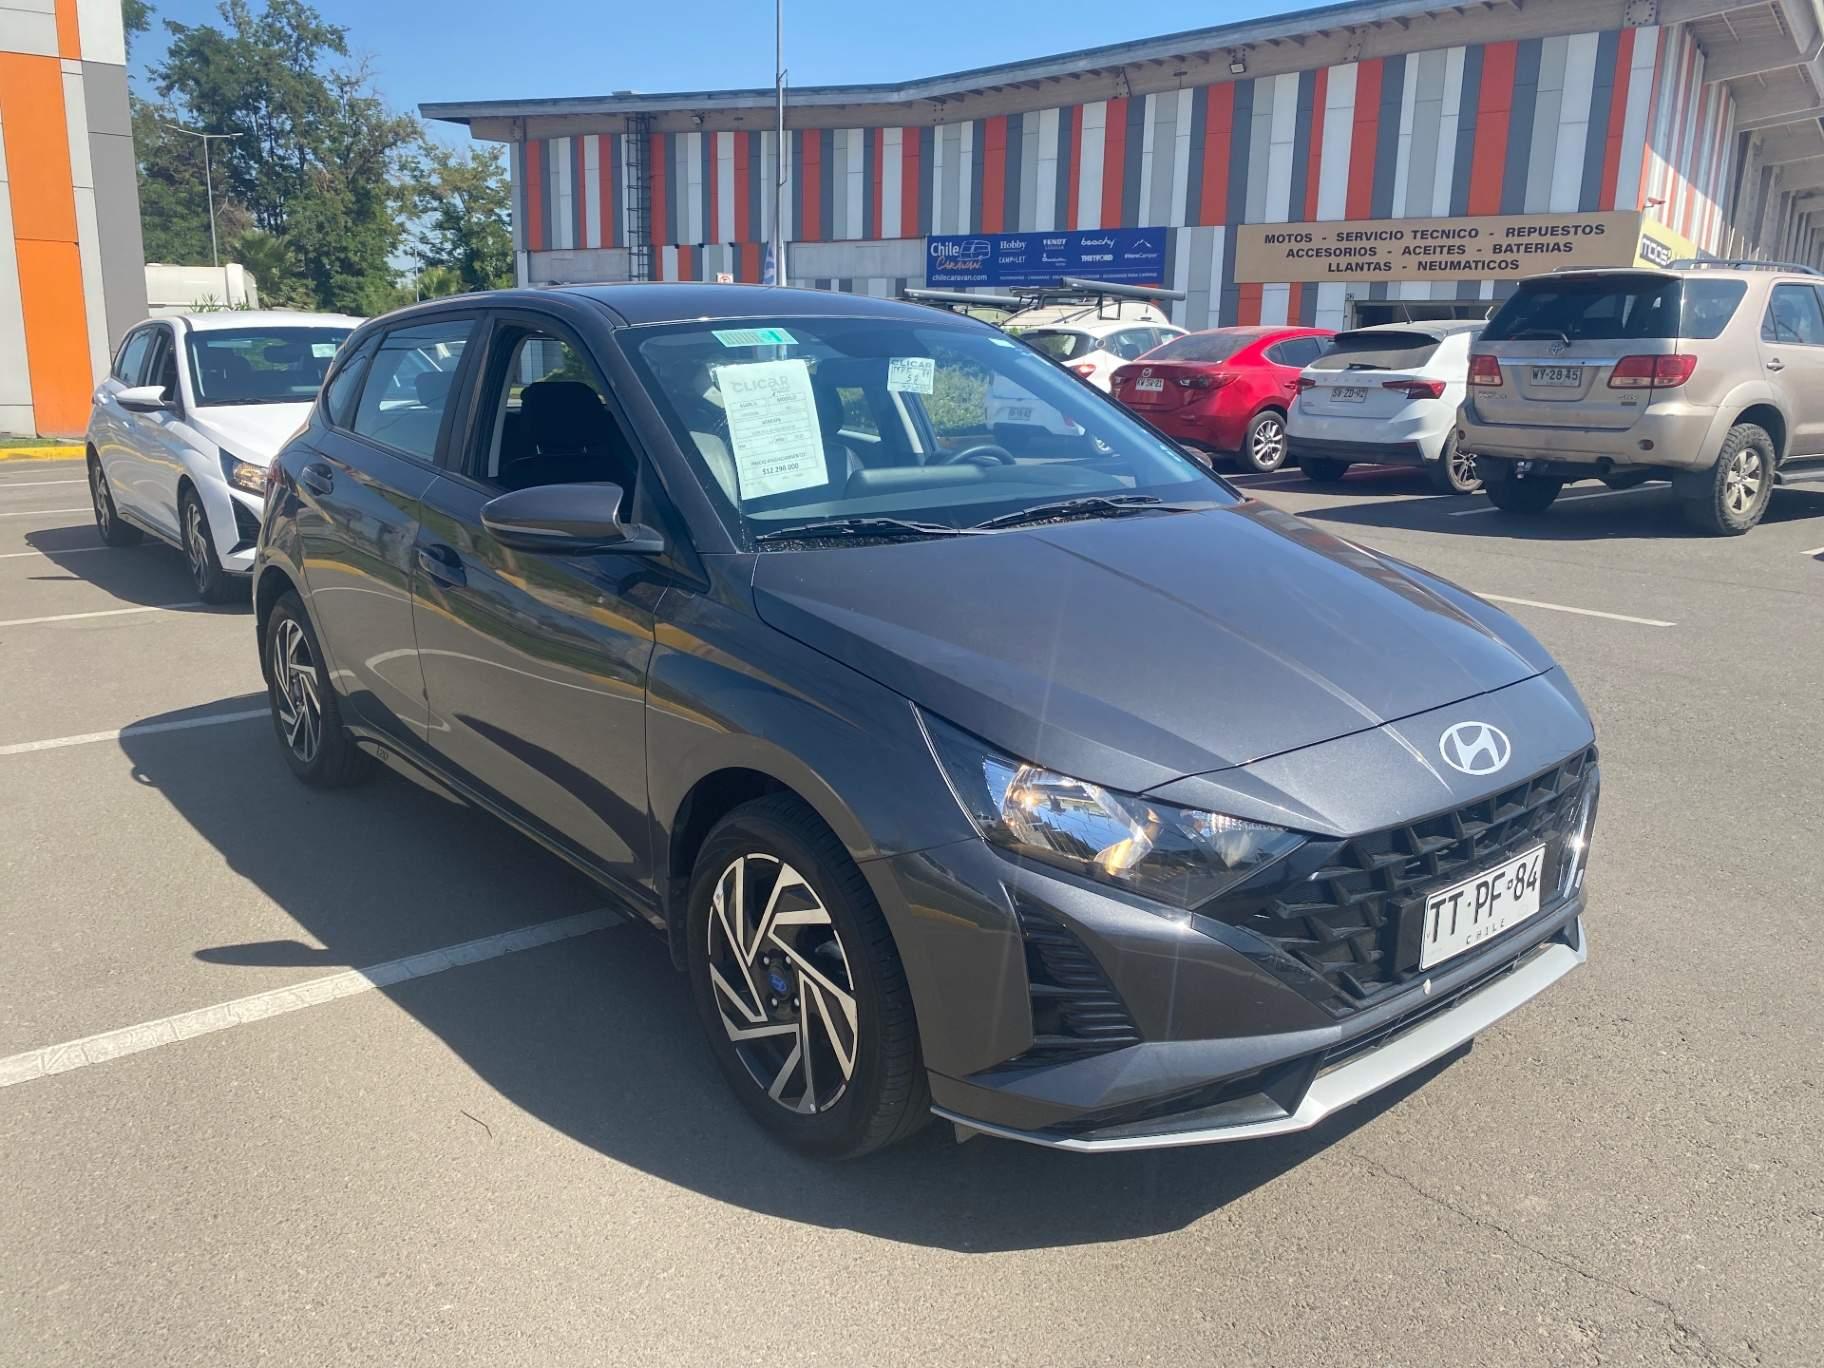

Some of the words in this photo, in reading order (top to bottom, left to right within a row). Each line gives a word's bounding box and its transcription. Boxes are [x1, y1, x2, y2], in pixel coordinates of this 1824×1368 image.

[1264, 232, 1313, 244] MOTOS
[1336, 229, 1405, 242] SERVICIO
[1411, 227, 1479, 241] TECNICO
[1505, 223, 1606, 238] REPUESTOS
[930, 241, 960, 257] Chile
[1000, 240, 1027, 250] Hobby
[1286, 246, 1377, 258] ACCESORIOS
[1401, 244, 1466, 256] ACEITES
[1492, 241, 1573, 254] BATERIAS
[1328, 261, 1392, 273] LLANTAS
[1417, 259, 1520, 271] NEUMATICOS
[1466, 918, 1505, 944] CHILE
